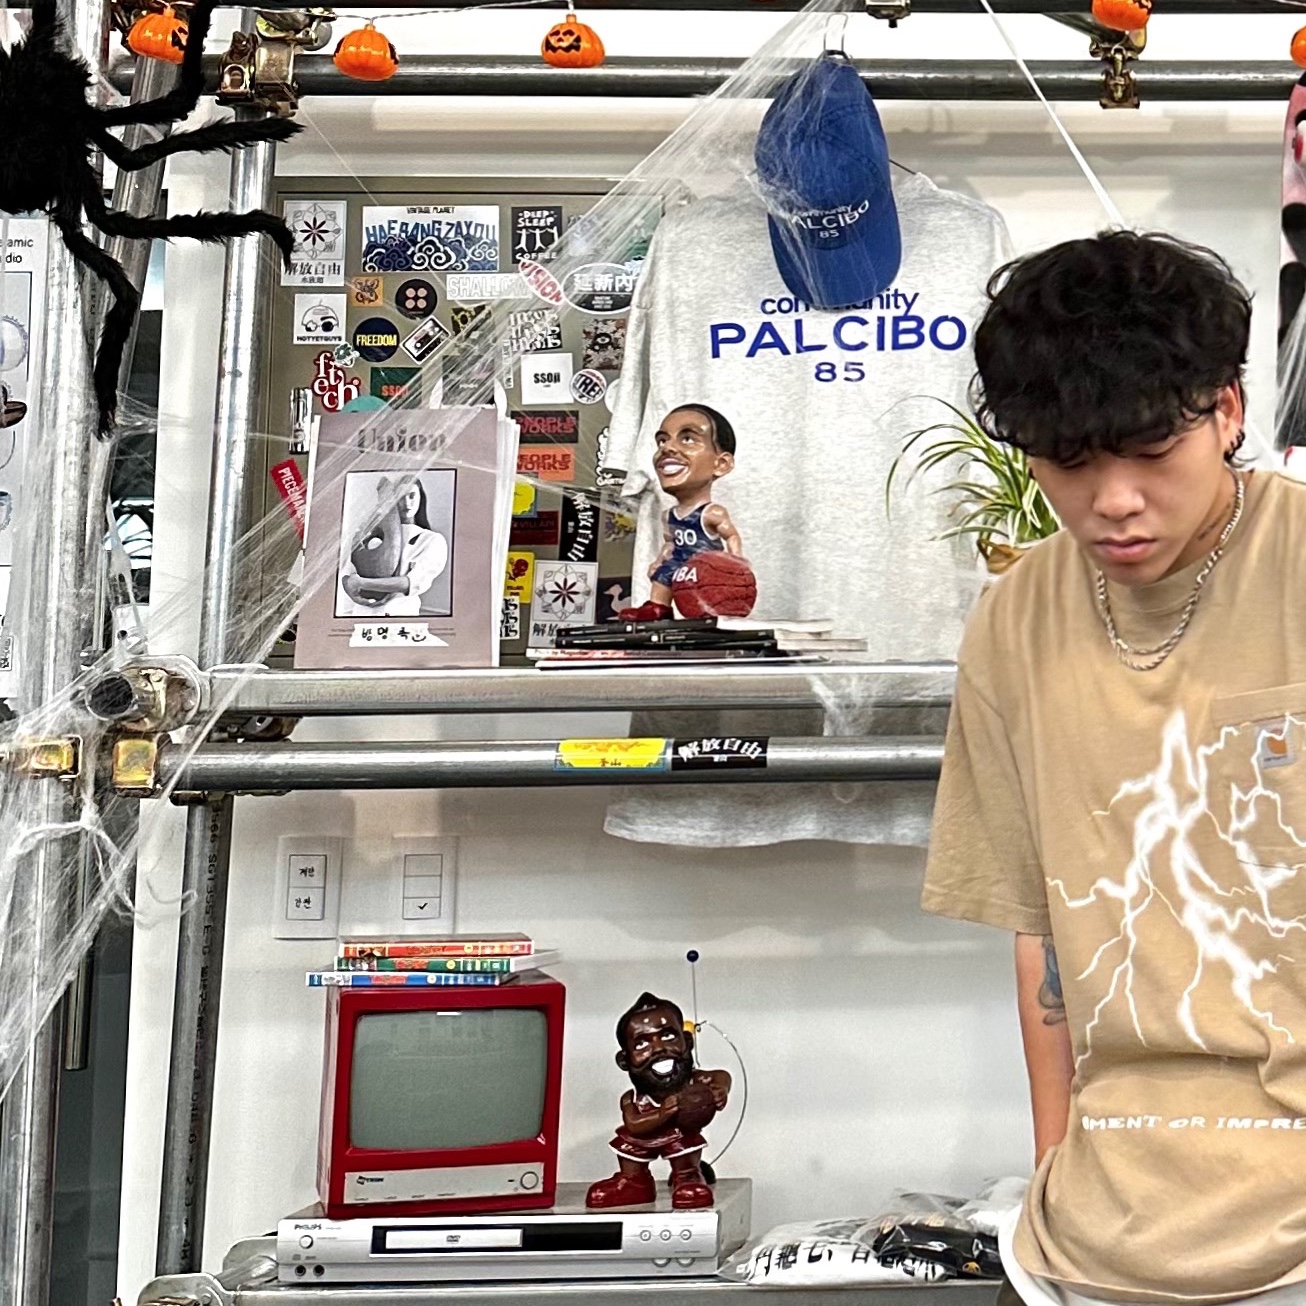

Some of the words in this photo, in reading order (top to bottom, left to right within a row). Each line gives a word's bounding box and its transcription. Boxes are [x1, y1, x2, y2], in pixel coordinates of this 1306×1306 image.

[517, 216, 555, 227] SLEEP
[819, 229, 840, 239] 85
[515, 252, 557, 261] COFFEE
[356, 334, 397, 347] FREEDOM
[709, 315, 967, 360] PALCIBO
[814, 361, 866, 383] 85
[674, 529, 698, 545] 30
[1168, 1116, 1206, 1130] OR
